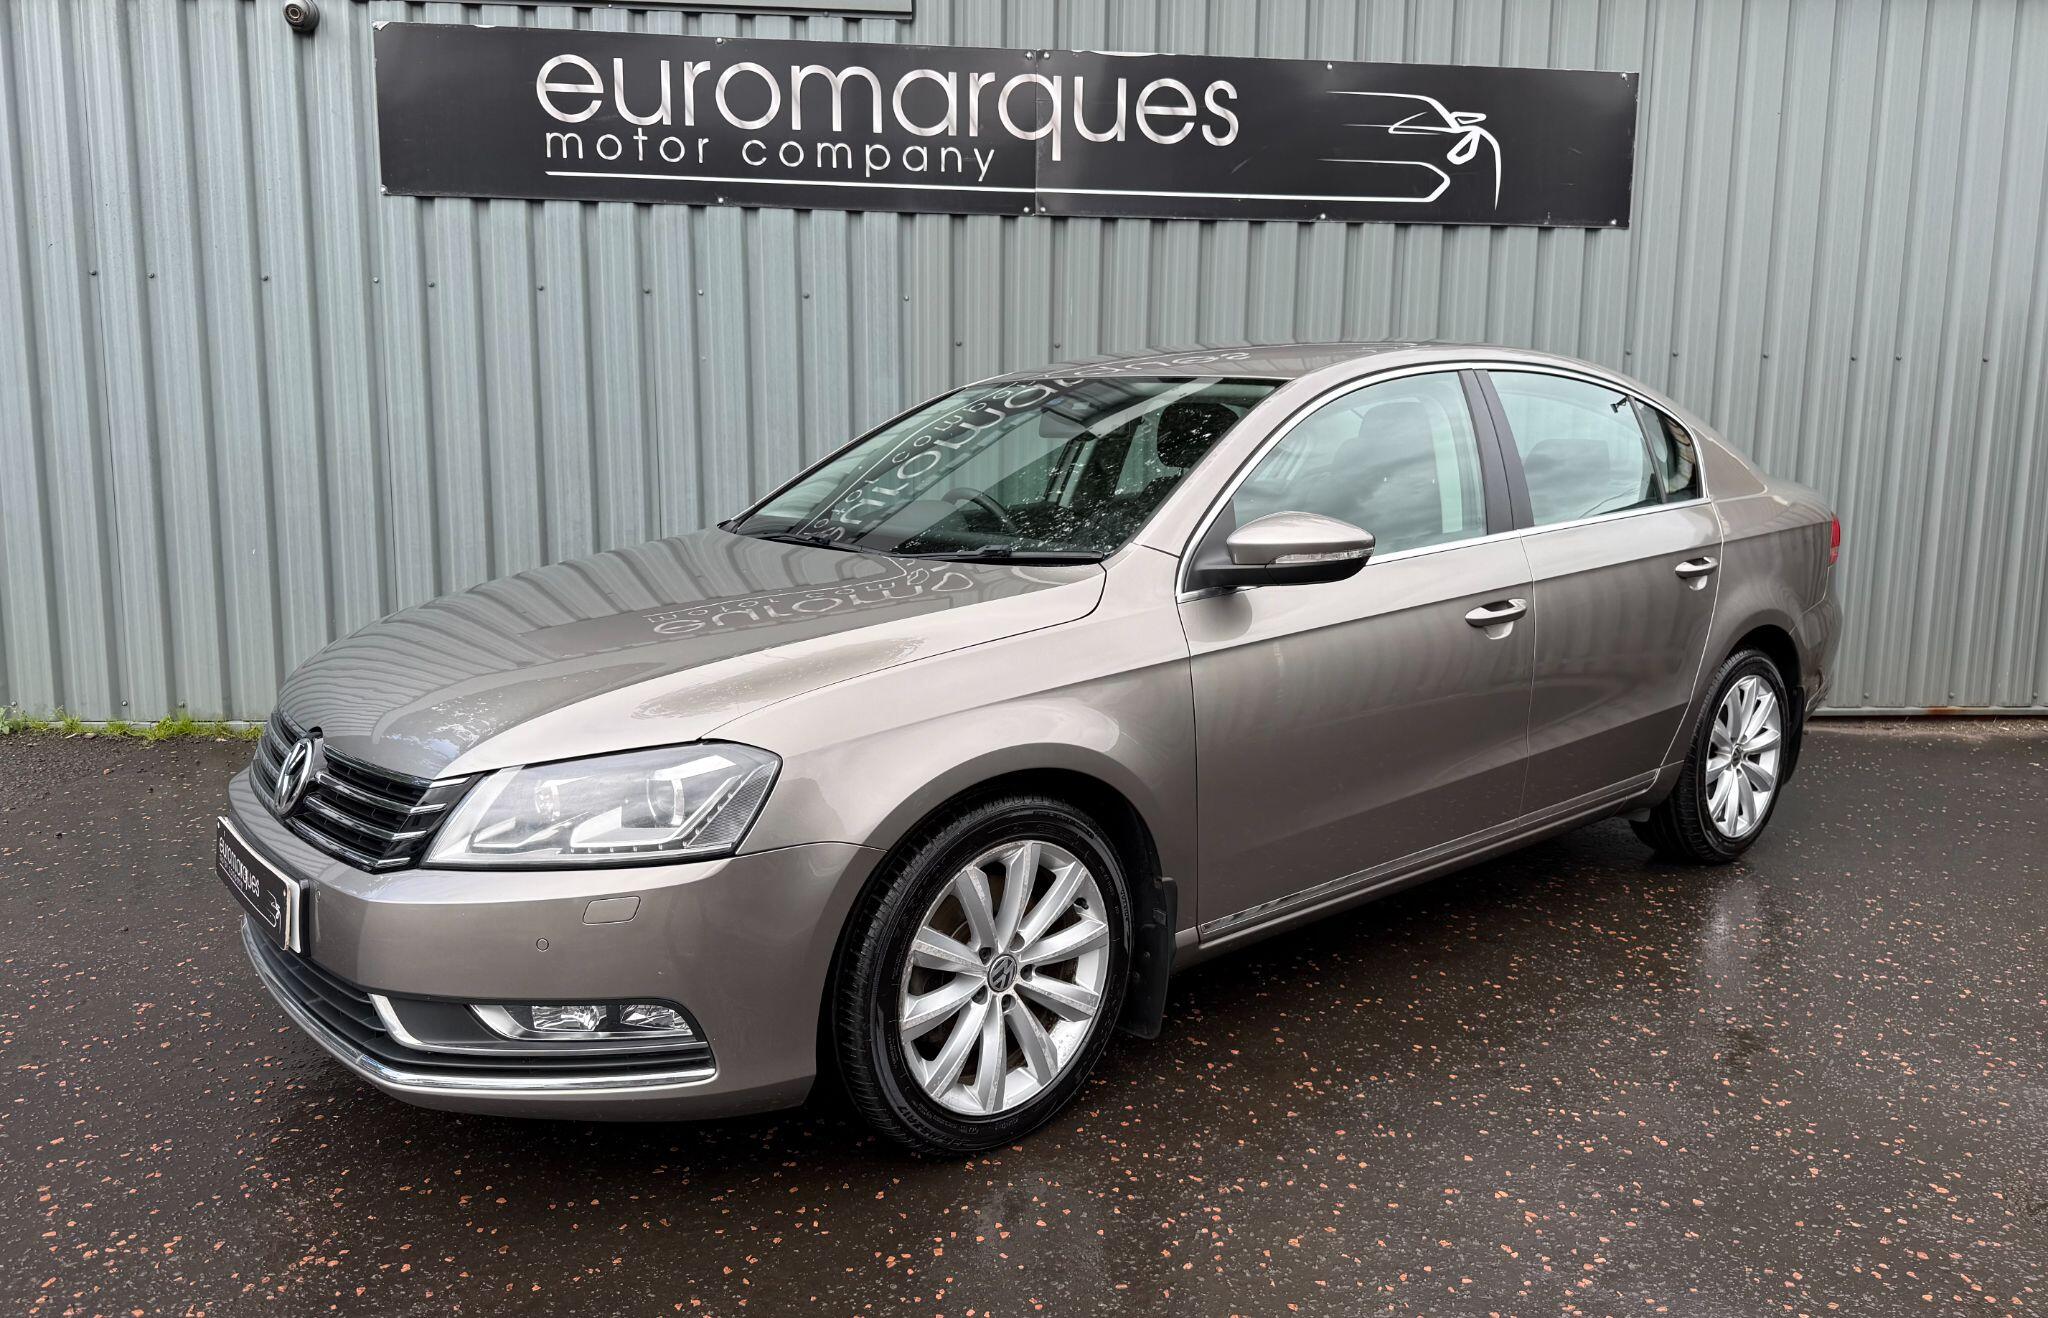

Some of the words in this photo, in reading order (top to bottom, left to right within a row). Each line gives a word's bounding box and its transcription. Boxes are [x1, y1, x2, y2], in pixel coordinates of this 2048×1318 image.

[536, 53, 1239, 162] euromarques
[545, 127, 709, 164] motor
[741, 139, 995, 182] company
[219, 836, 260, 898] euromarques
